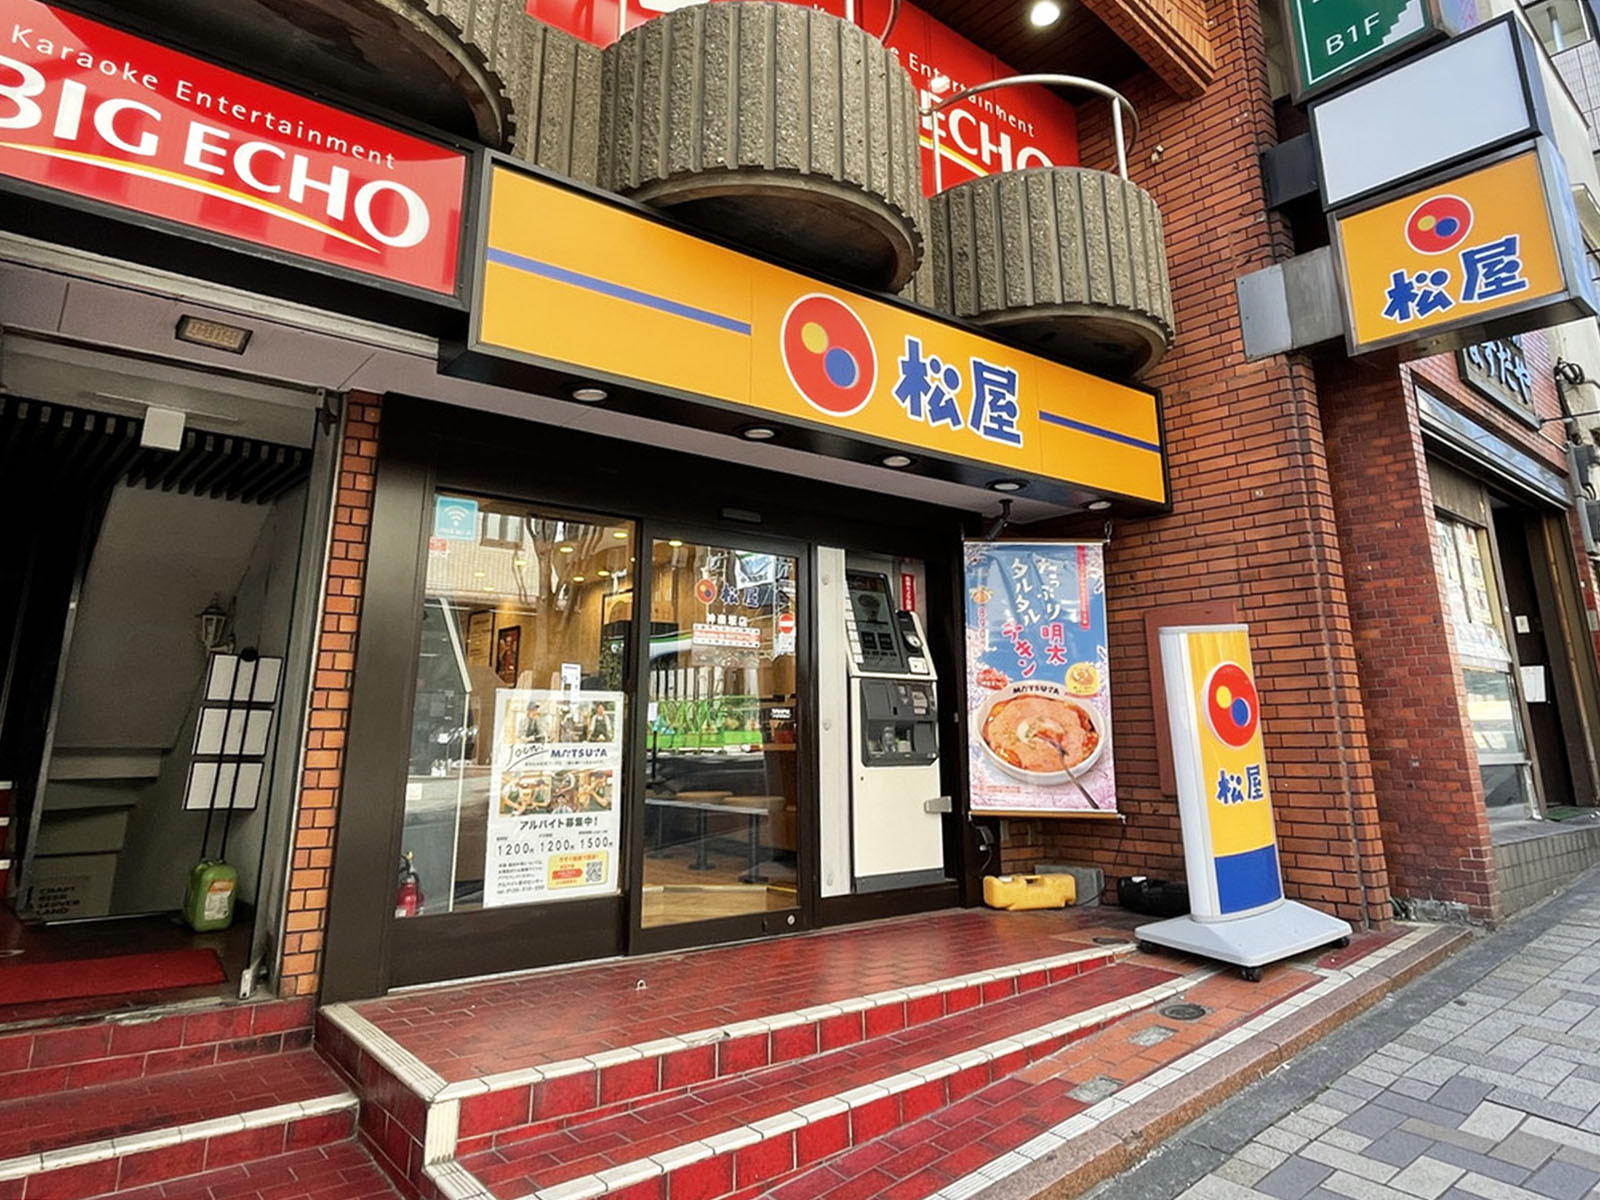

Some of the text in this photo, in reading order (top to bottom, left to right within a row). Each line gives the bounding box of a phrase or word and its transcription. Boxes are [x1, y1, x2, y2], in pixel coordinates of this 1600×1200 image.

[1325, 11, 1380, 56] B1F
[12, 24, 396, 169] Karaoke Entertainment
[909, 52, 1034, 137] Entrtainment
[0, 57, 430, 248] BIG ECHO
[1382, 234, 1529, 322] 松屋
[891, 335, 1024, 448] 松屋
[720, 582, 759, 608] 松屋
[1013, 685, 1059, 695] MATSUYA
[550, 748, 608, 758] MATSUYA
[1216, 764, 1264, 804] 松屋
